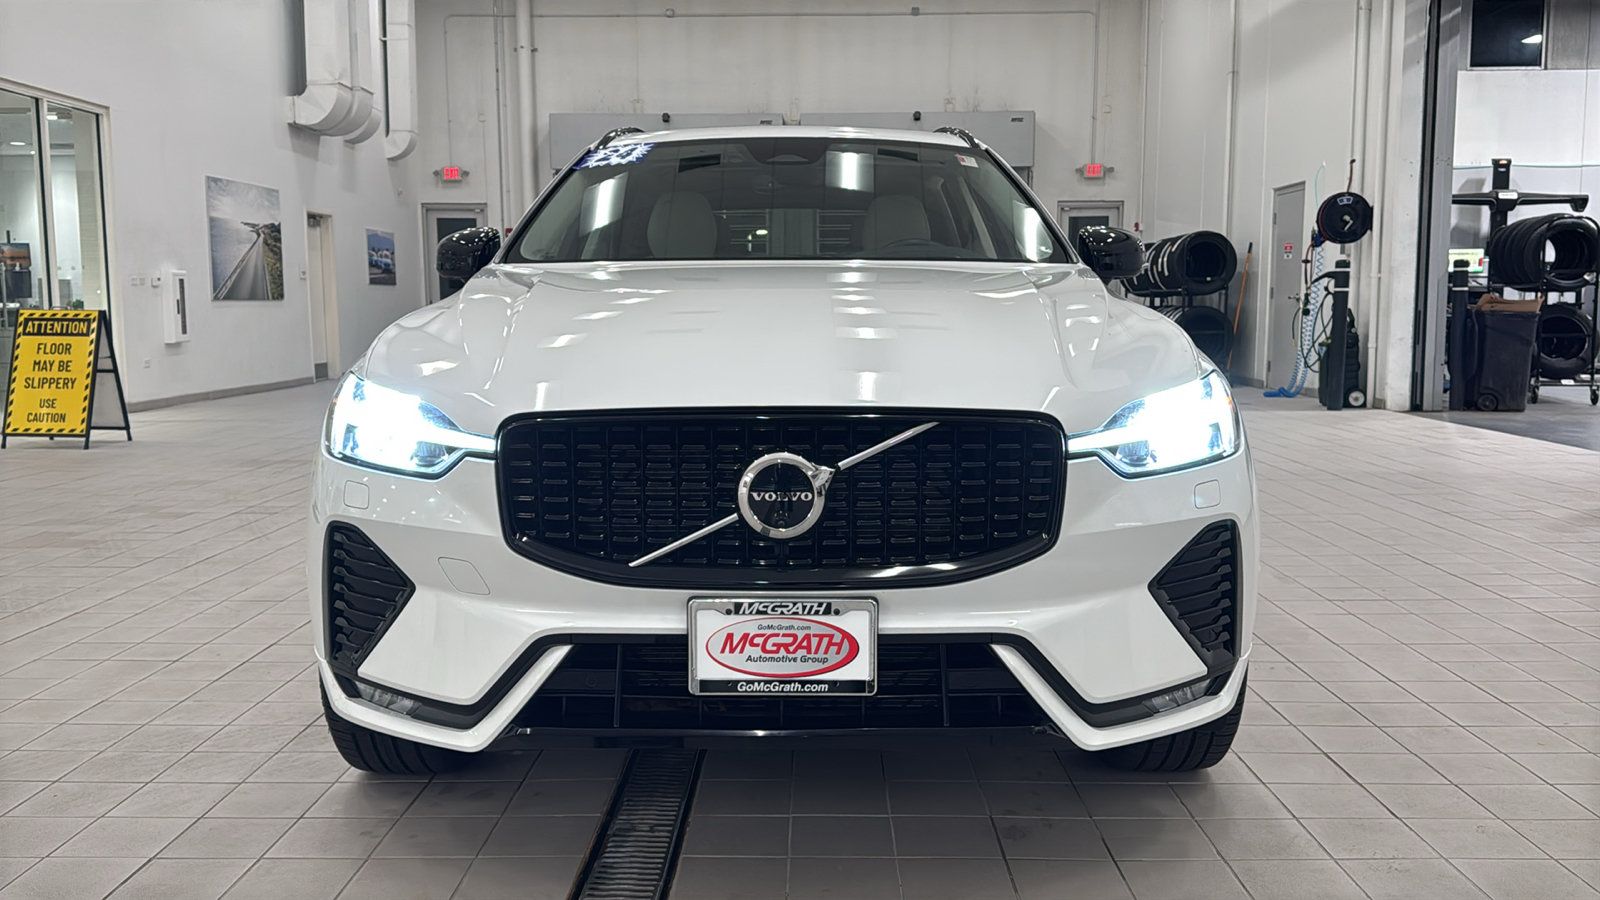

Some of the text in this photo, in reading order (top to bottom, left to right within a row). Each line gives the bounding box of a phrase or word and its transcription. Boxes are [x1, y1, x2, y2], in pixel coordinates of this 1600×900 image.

[25, 321, 87, 334] ATTENTION
[36, 343, 72, 355] FLOOR
[32, 360, 72, 372] MAY BE
[24, 377, 76, 389] SLIPPERY
[39, 398, 57, 409] USE
[26, 412, 66, 423] CAUTION
[750, 491, 813, 502] VOLVO
[757, 623, 812, 632] GoMcGrath.com
[745, 654, 829, 665] Automotive Group
[737, 681, 829, 693] GoMcGrath.com
